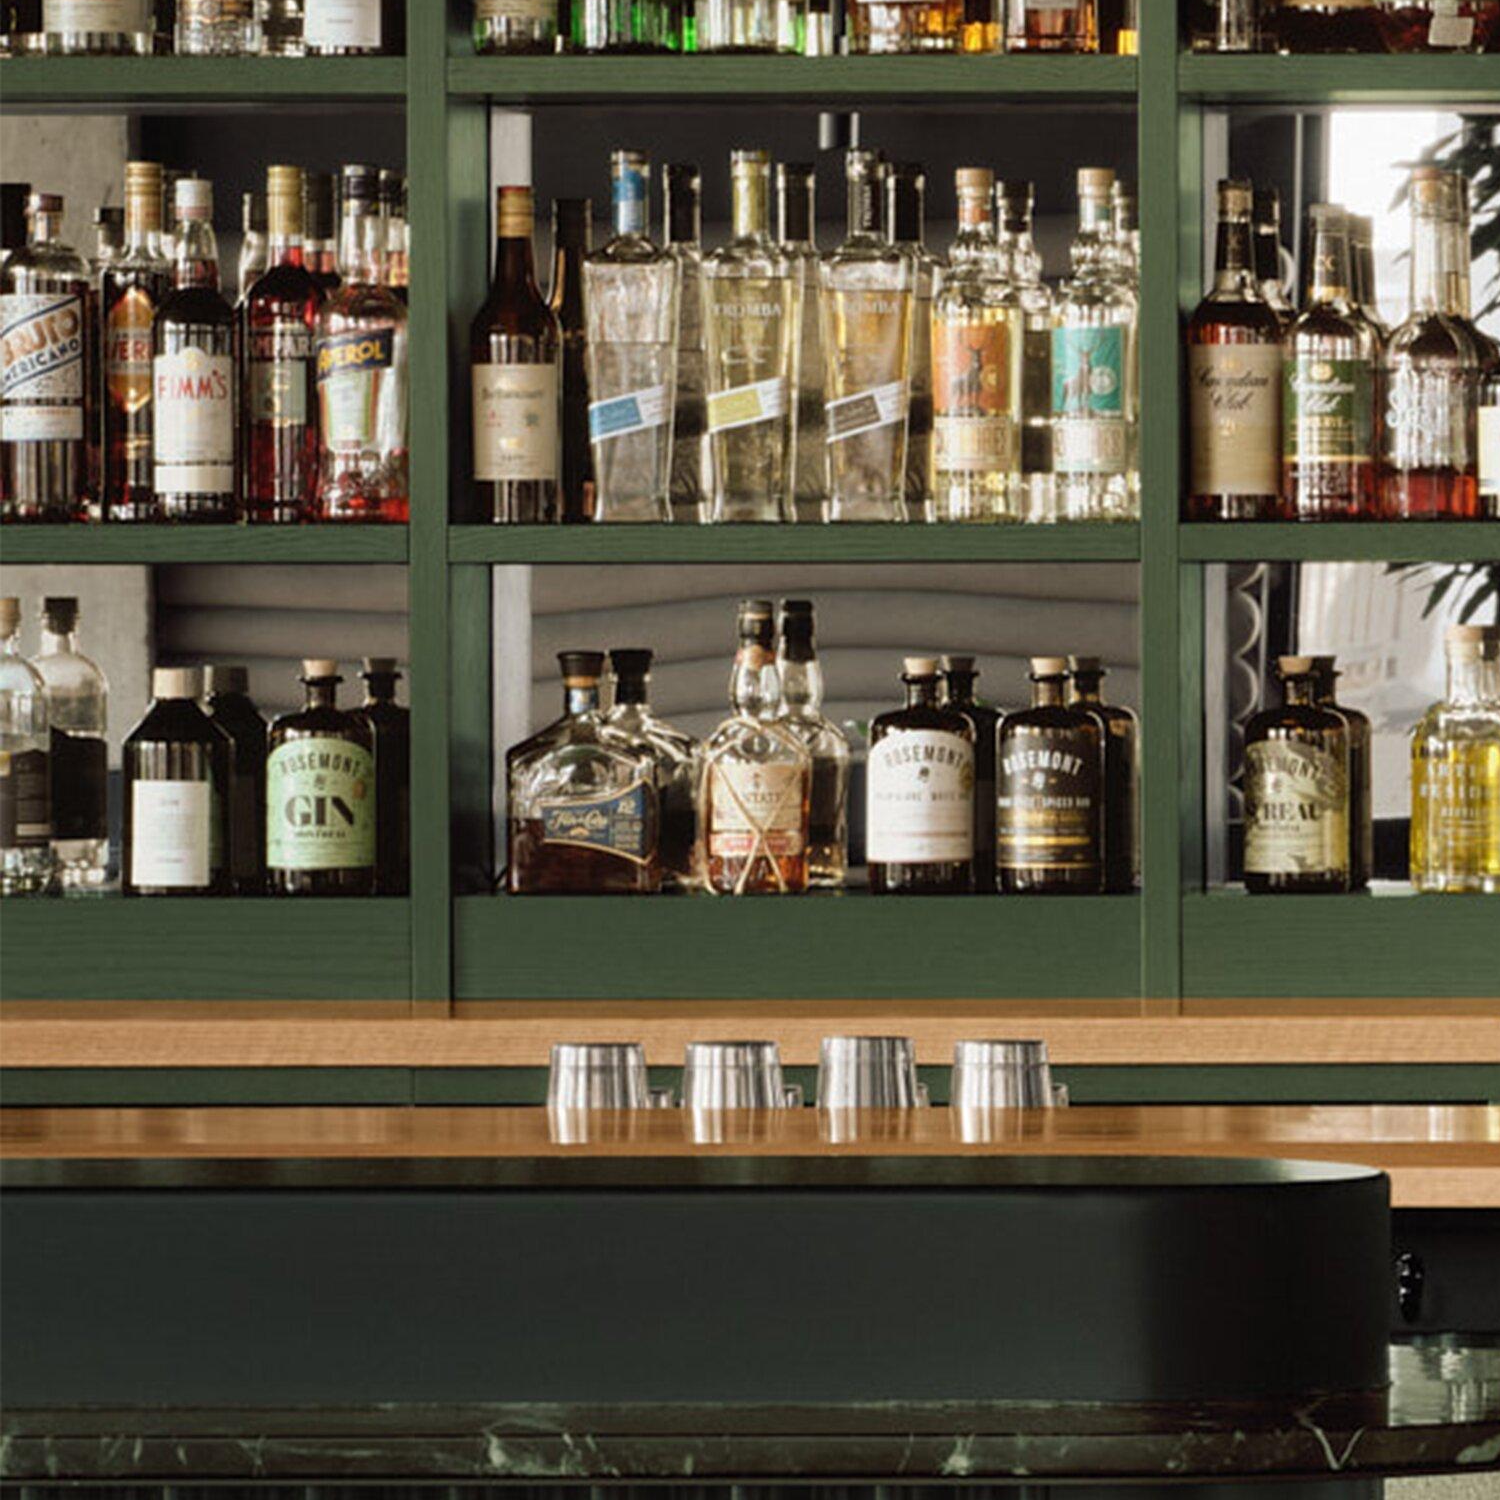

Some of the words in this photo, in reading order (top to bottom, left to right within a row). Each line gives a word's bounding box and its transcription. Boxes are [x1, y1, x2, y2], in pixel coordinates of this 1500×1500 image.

[318, 340, 385, 373] APEROL
[1002, 750, 1084, 776] ROSEMONT
[285, 795, 355, 827] GIN
